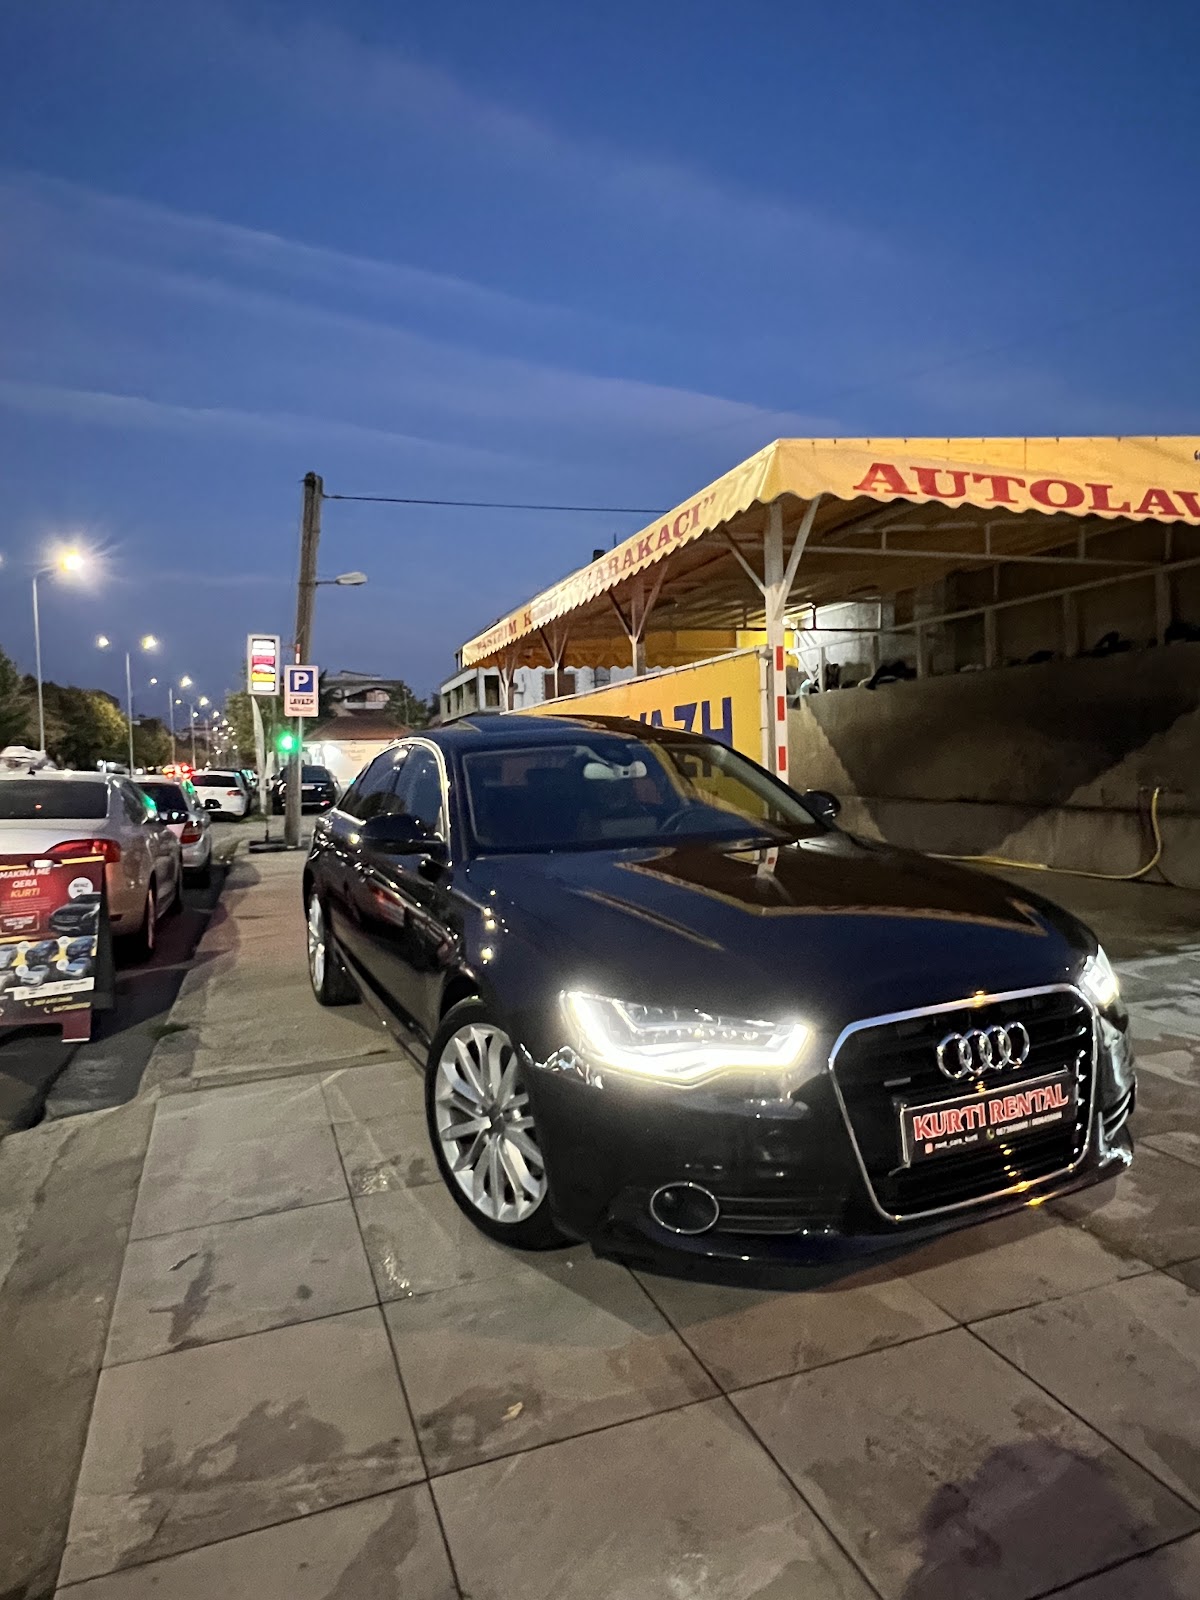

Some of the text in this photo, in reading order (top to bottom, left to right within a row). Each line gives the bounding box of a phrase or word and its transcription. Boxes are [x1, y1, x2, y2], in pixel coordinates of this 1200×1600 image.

[294, 672, 309, 690] P
[12, 879, 37, 889] QERA
[10, 887, 40, 898] KURTI
[913, 1103, 986, 1141] KURTI
[989, 1083, 1069, 1124] RENTAL
